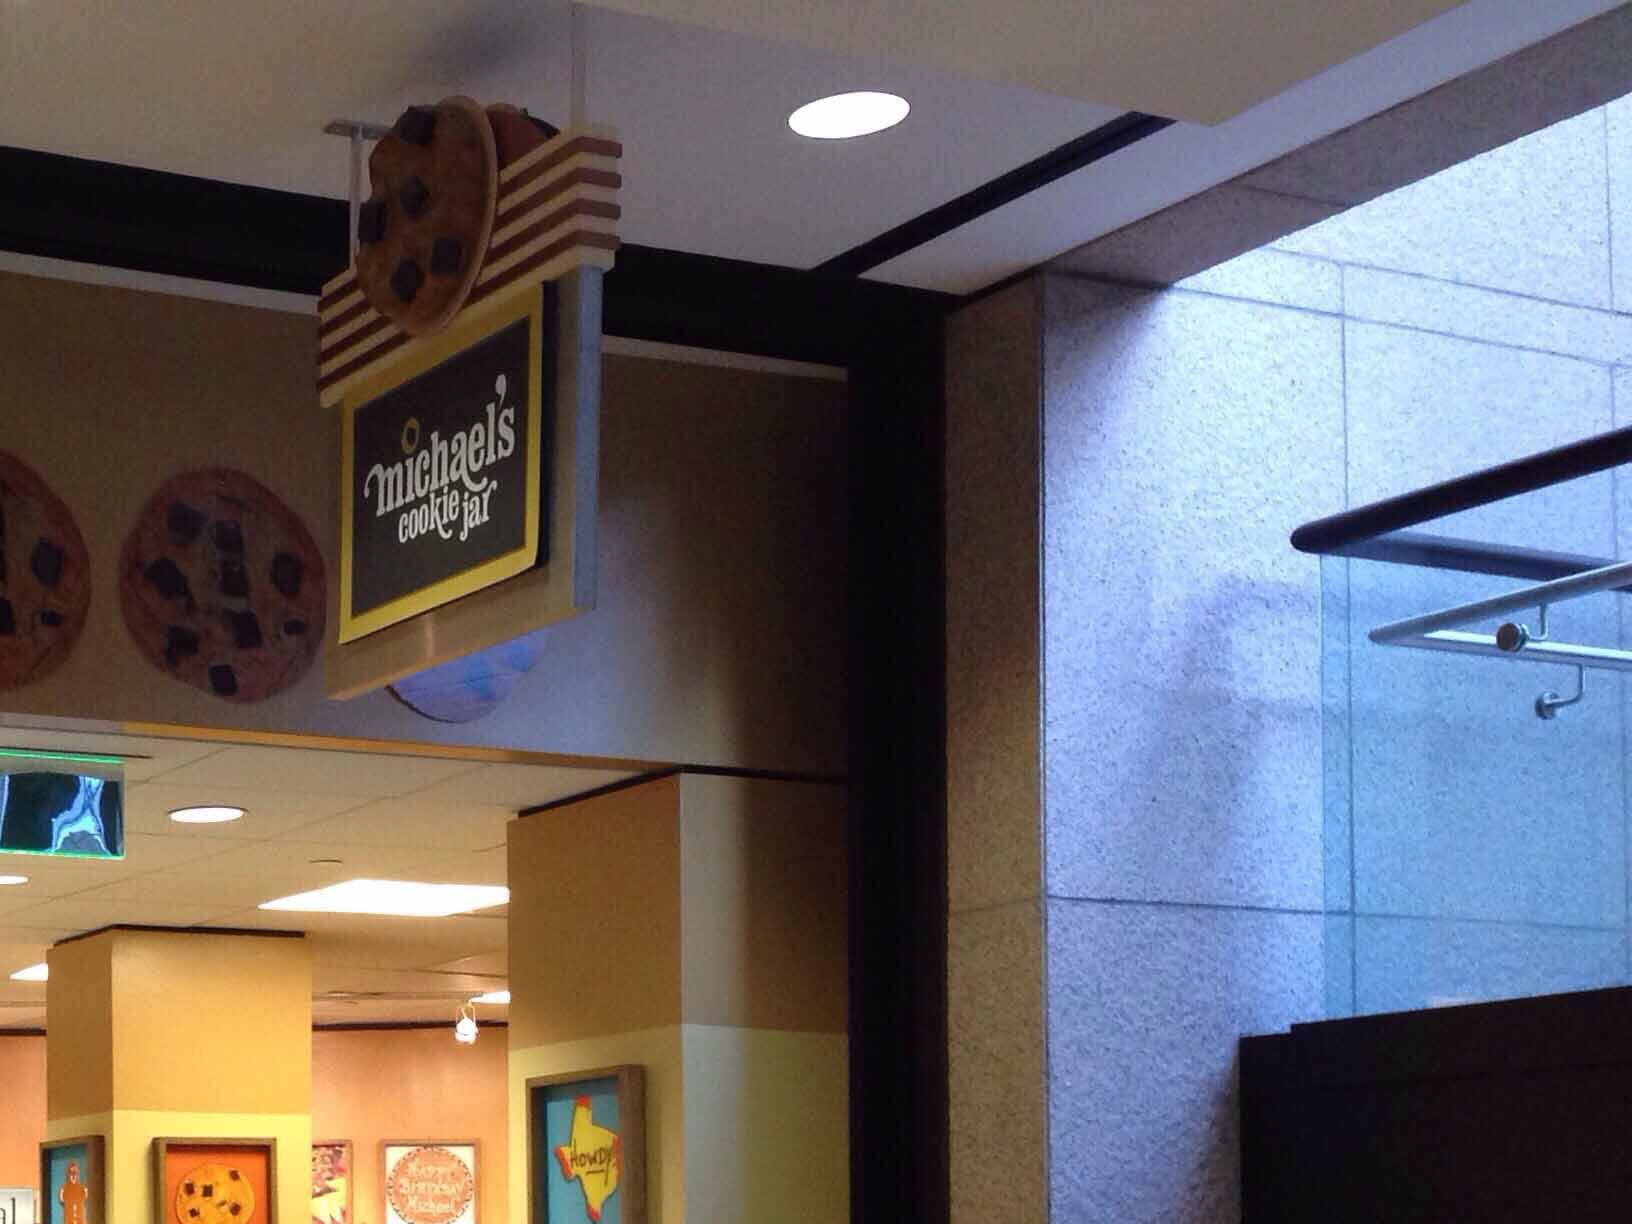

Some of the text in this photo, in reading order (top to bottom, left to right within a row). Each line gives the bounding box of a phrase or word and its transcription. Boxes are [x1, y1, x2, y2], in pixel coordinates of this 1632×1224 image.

[364, 374, 515, 517] michael's
[398, 480, 498, 543] cookie jar
